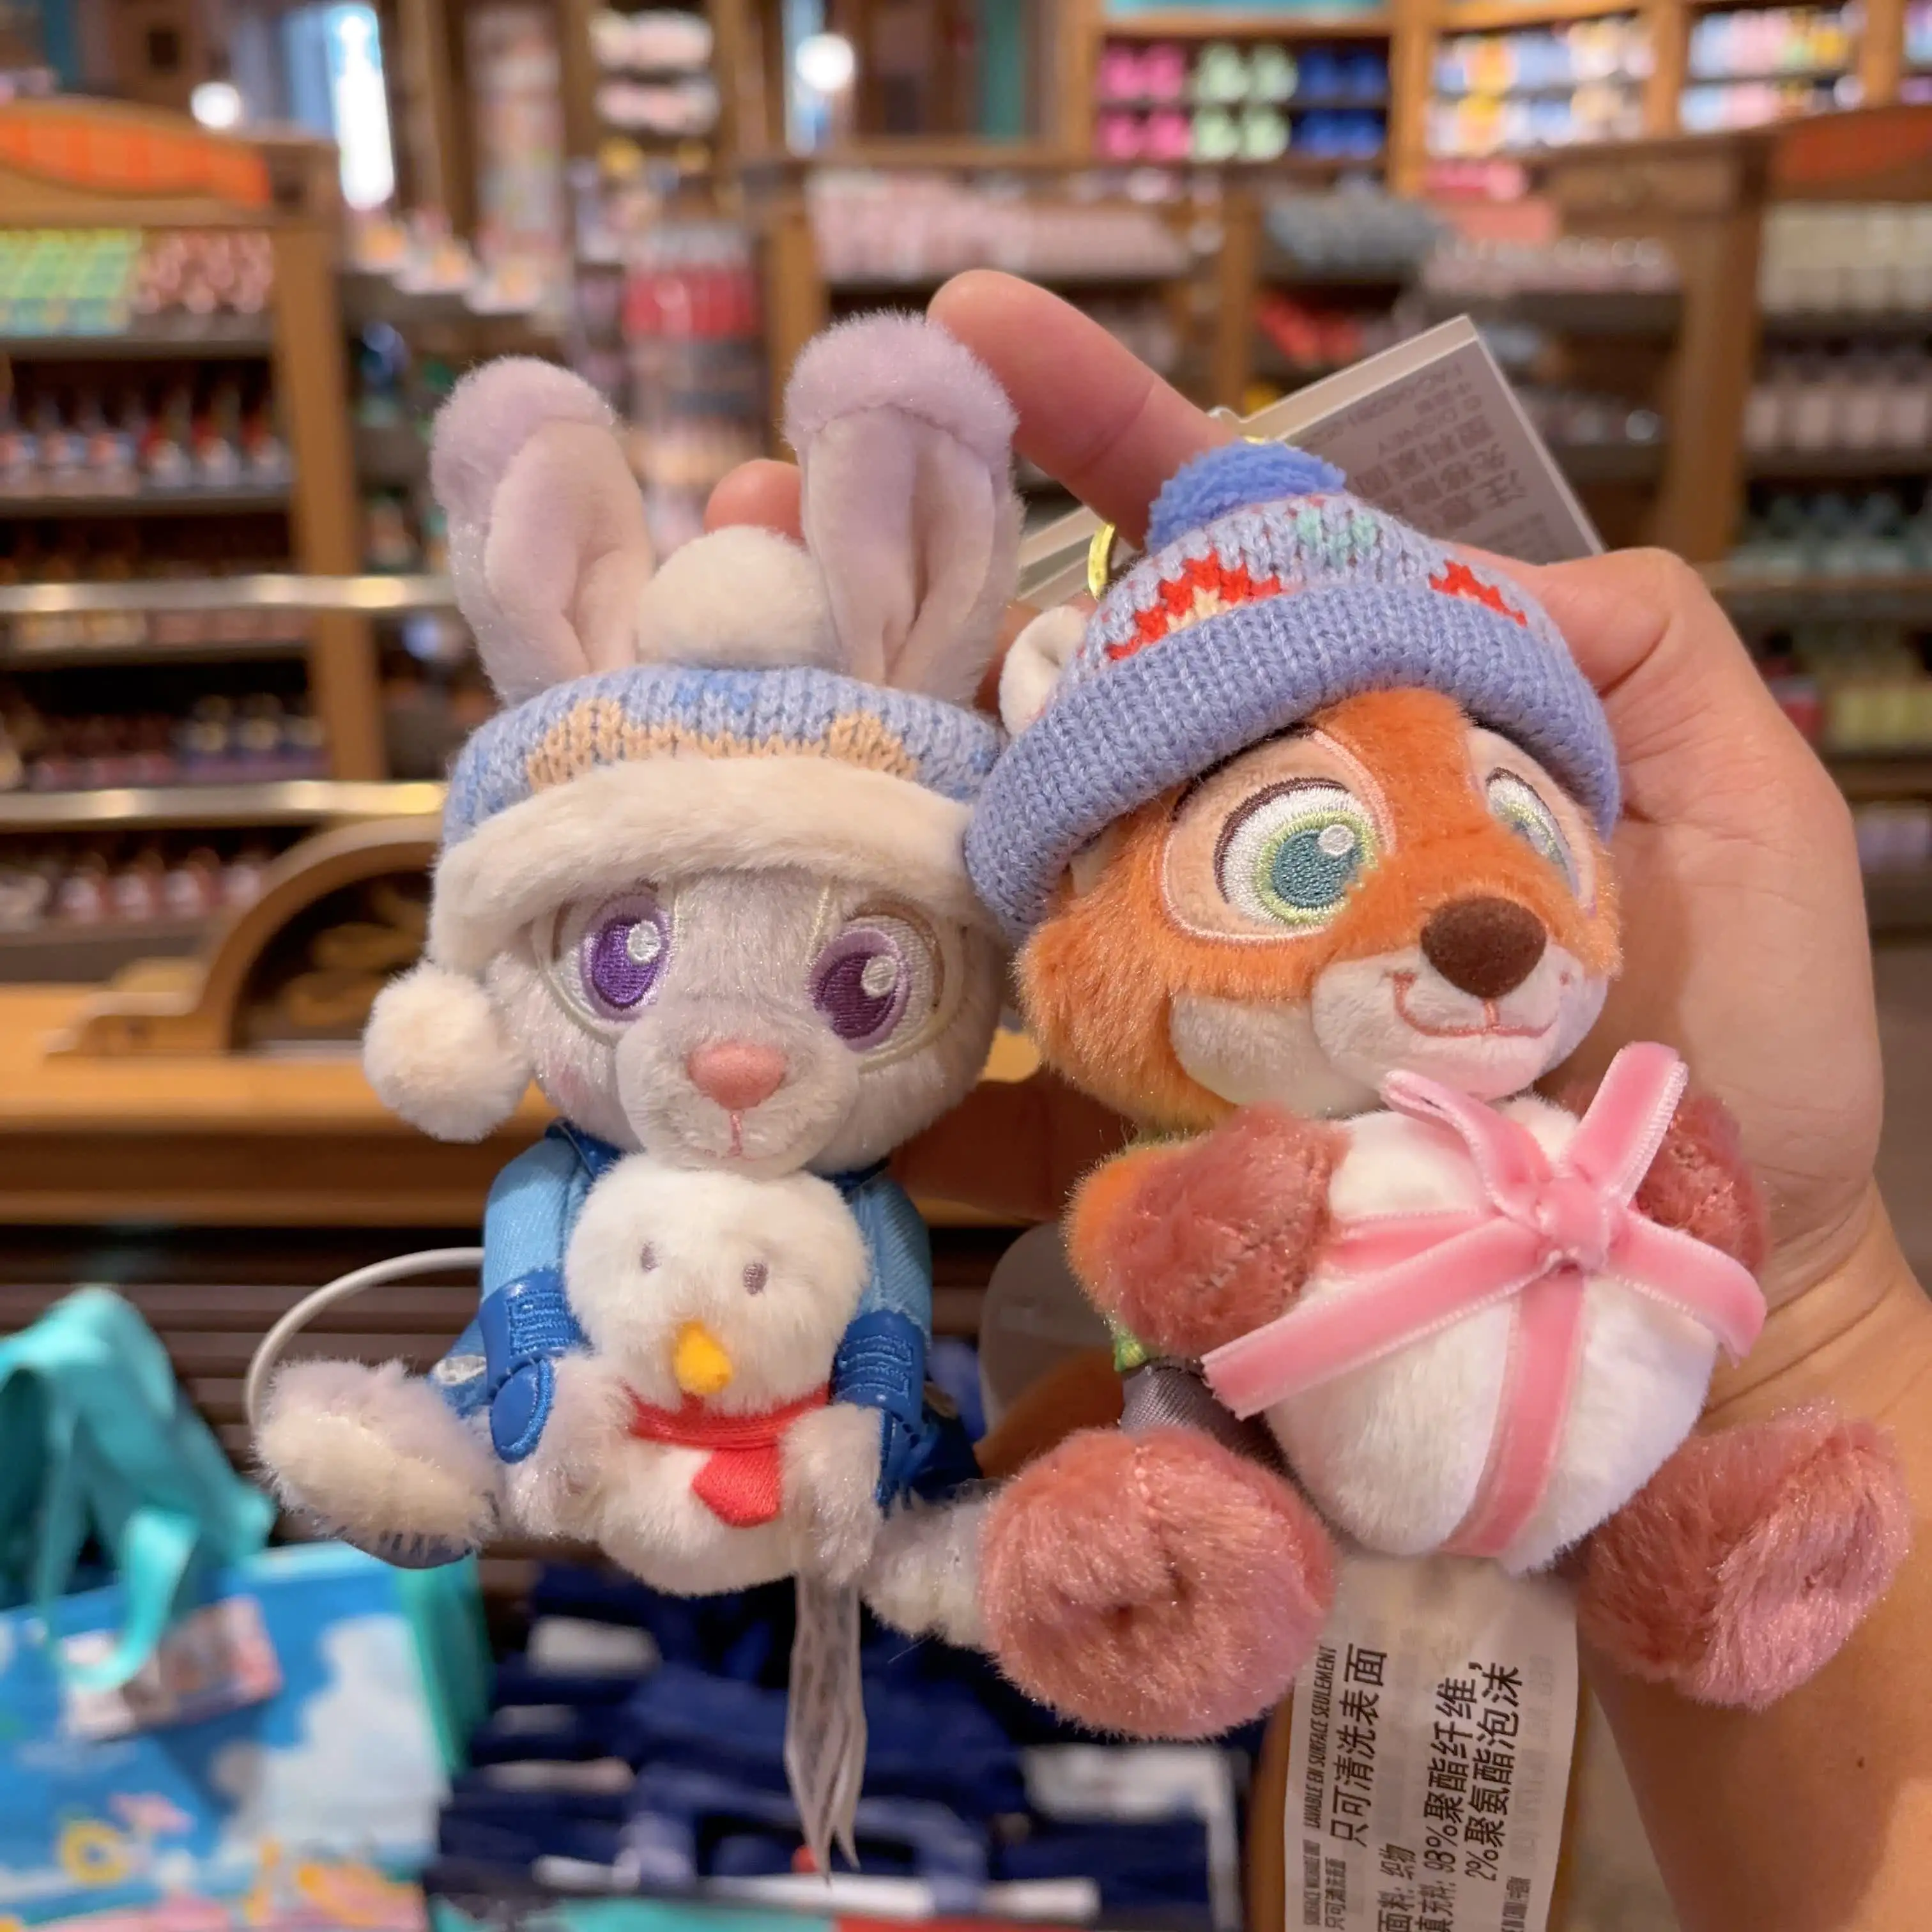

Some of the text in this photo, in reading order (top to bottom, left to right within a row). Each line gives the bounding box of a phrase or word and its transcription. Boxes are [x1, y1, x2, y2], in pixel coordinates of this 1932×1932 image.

[1311, 1644, 1337, 1718] SEULEMENT
[1308, 1717, 1328, 1766] SURFACE
[1330, 1643, 1387, 1848] 只可清洗表面
[1464, 1662, 1523, 1882] 2%聚氨酯泡沫
[1307, 1765, 1323, 1783] EN
[1303, 1784, 1322, 1829] LAVABLE
